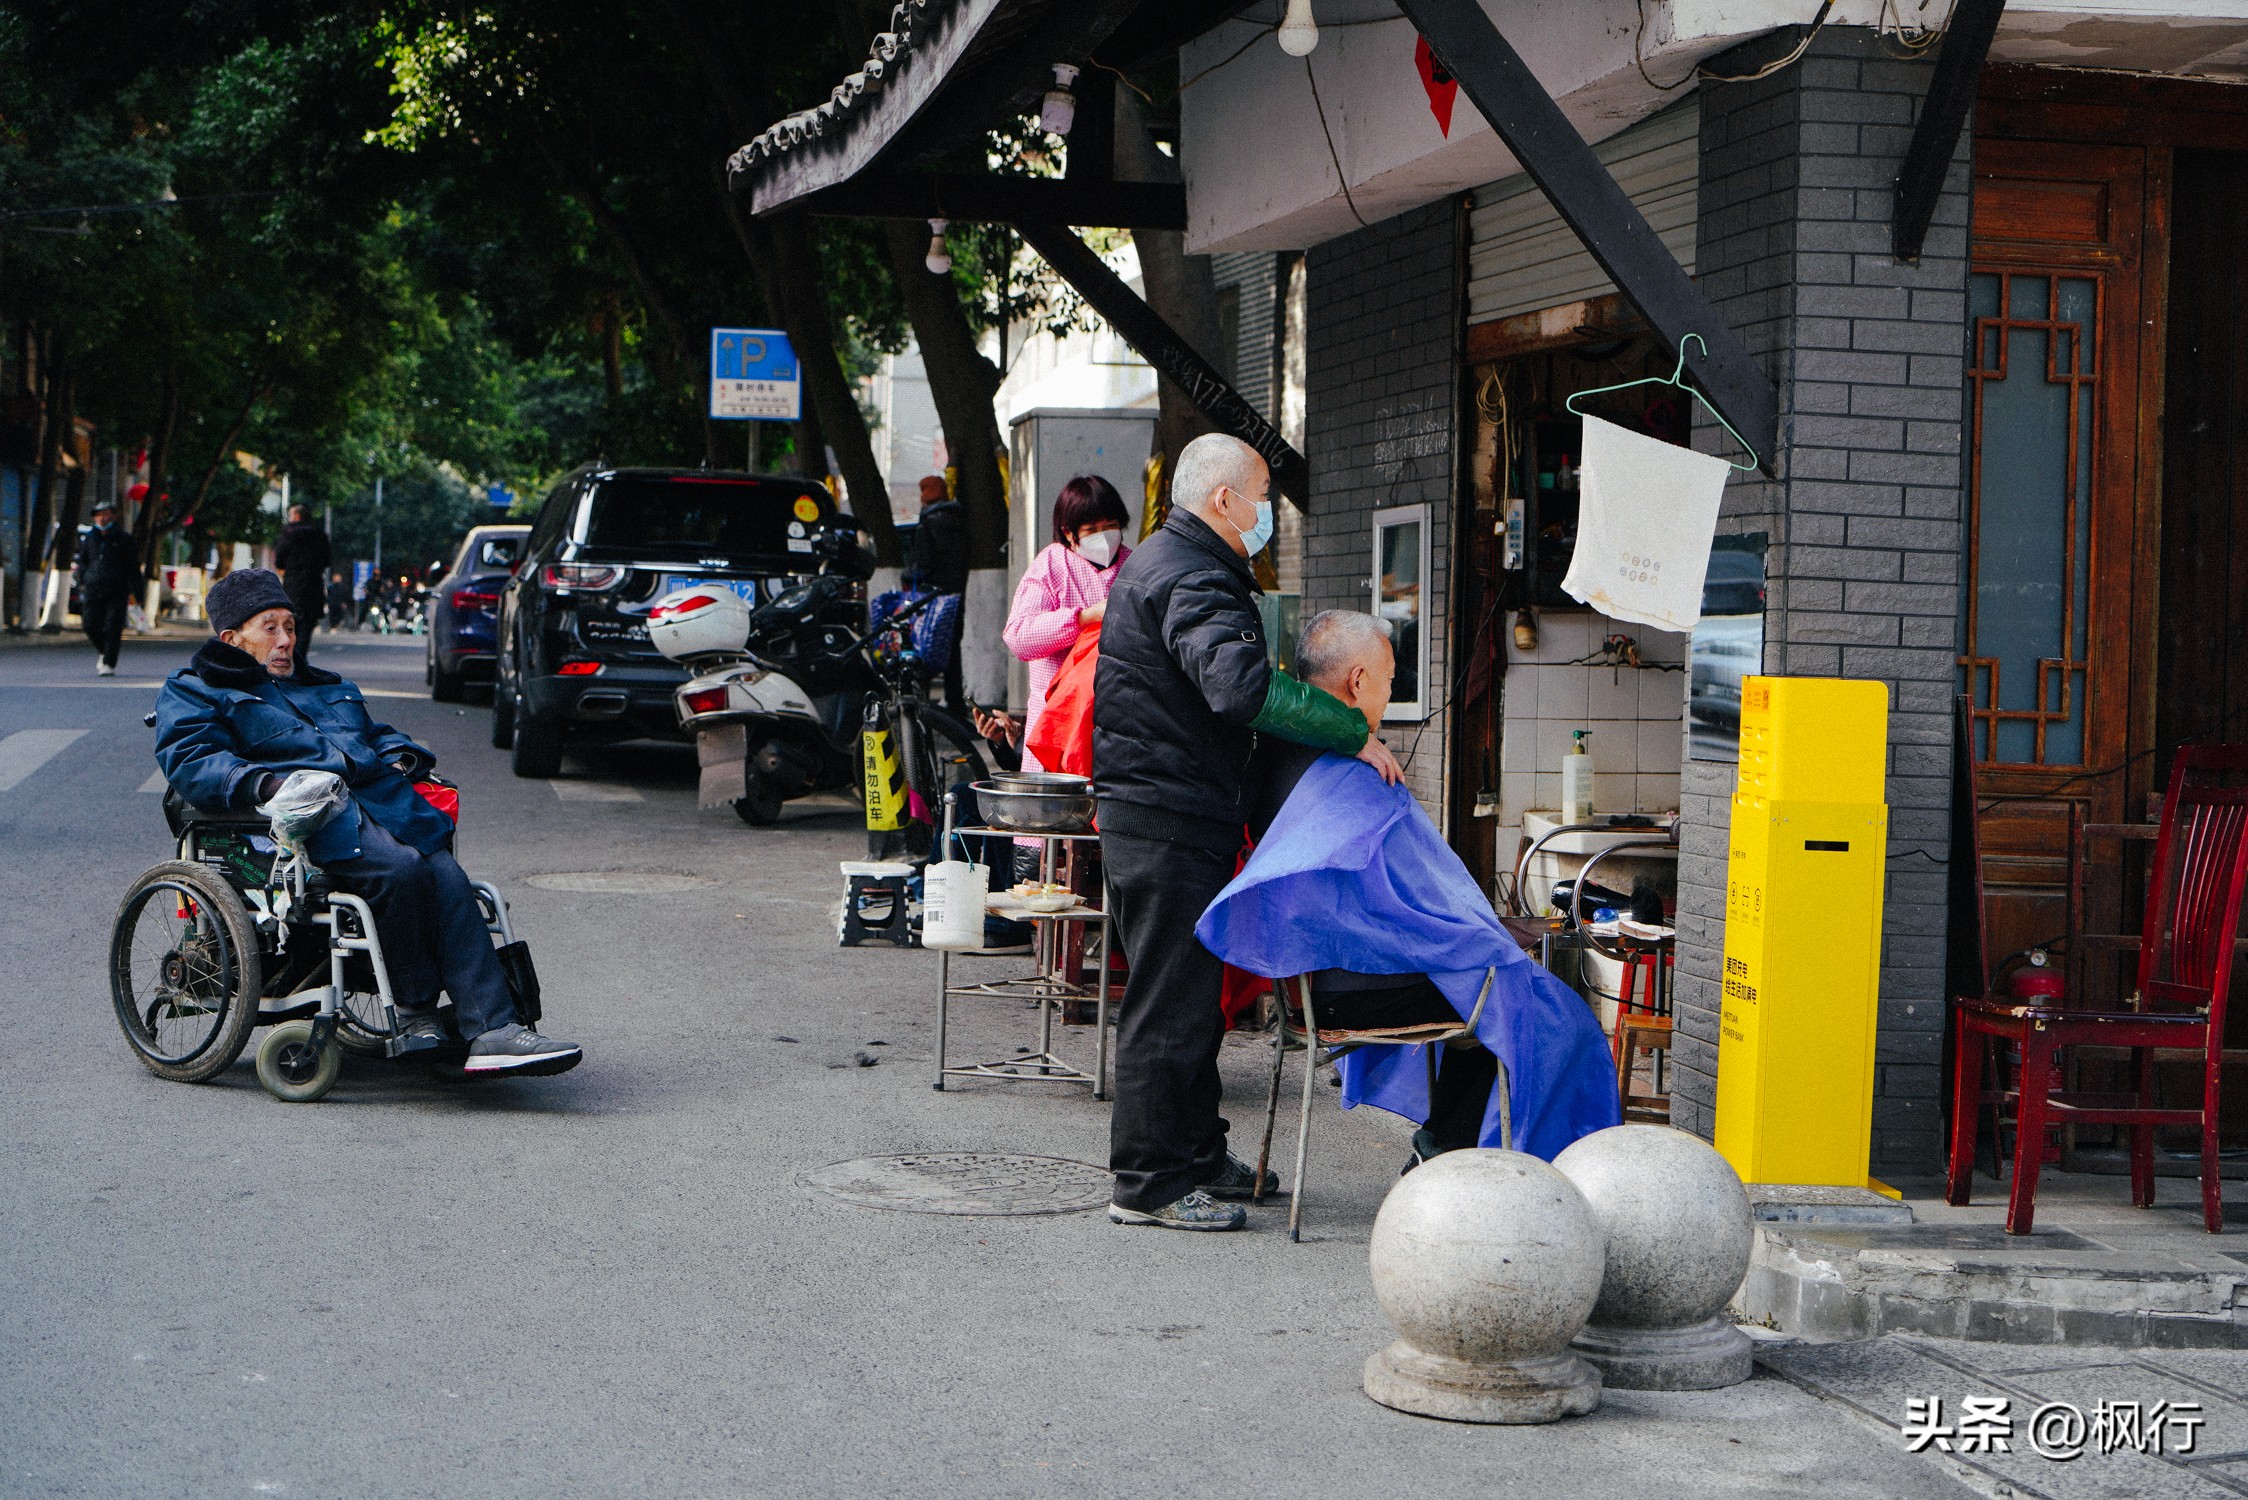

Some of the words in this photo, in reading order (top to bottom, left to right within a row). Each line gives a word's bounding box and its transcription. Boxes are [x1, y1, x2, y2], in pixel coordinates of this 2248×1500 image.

[741, 336, 767, 377] P
[865, 755, 883, 822] 请勿泊车
[1726, 956, 1748, 979] 美团充电
[1725, 977, 1757, 1005] 给生活加满电
[1723, 1010, 1739, 1025] MEITUAN
[1722, 1026, 1736, 1039] POWER
